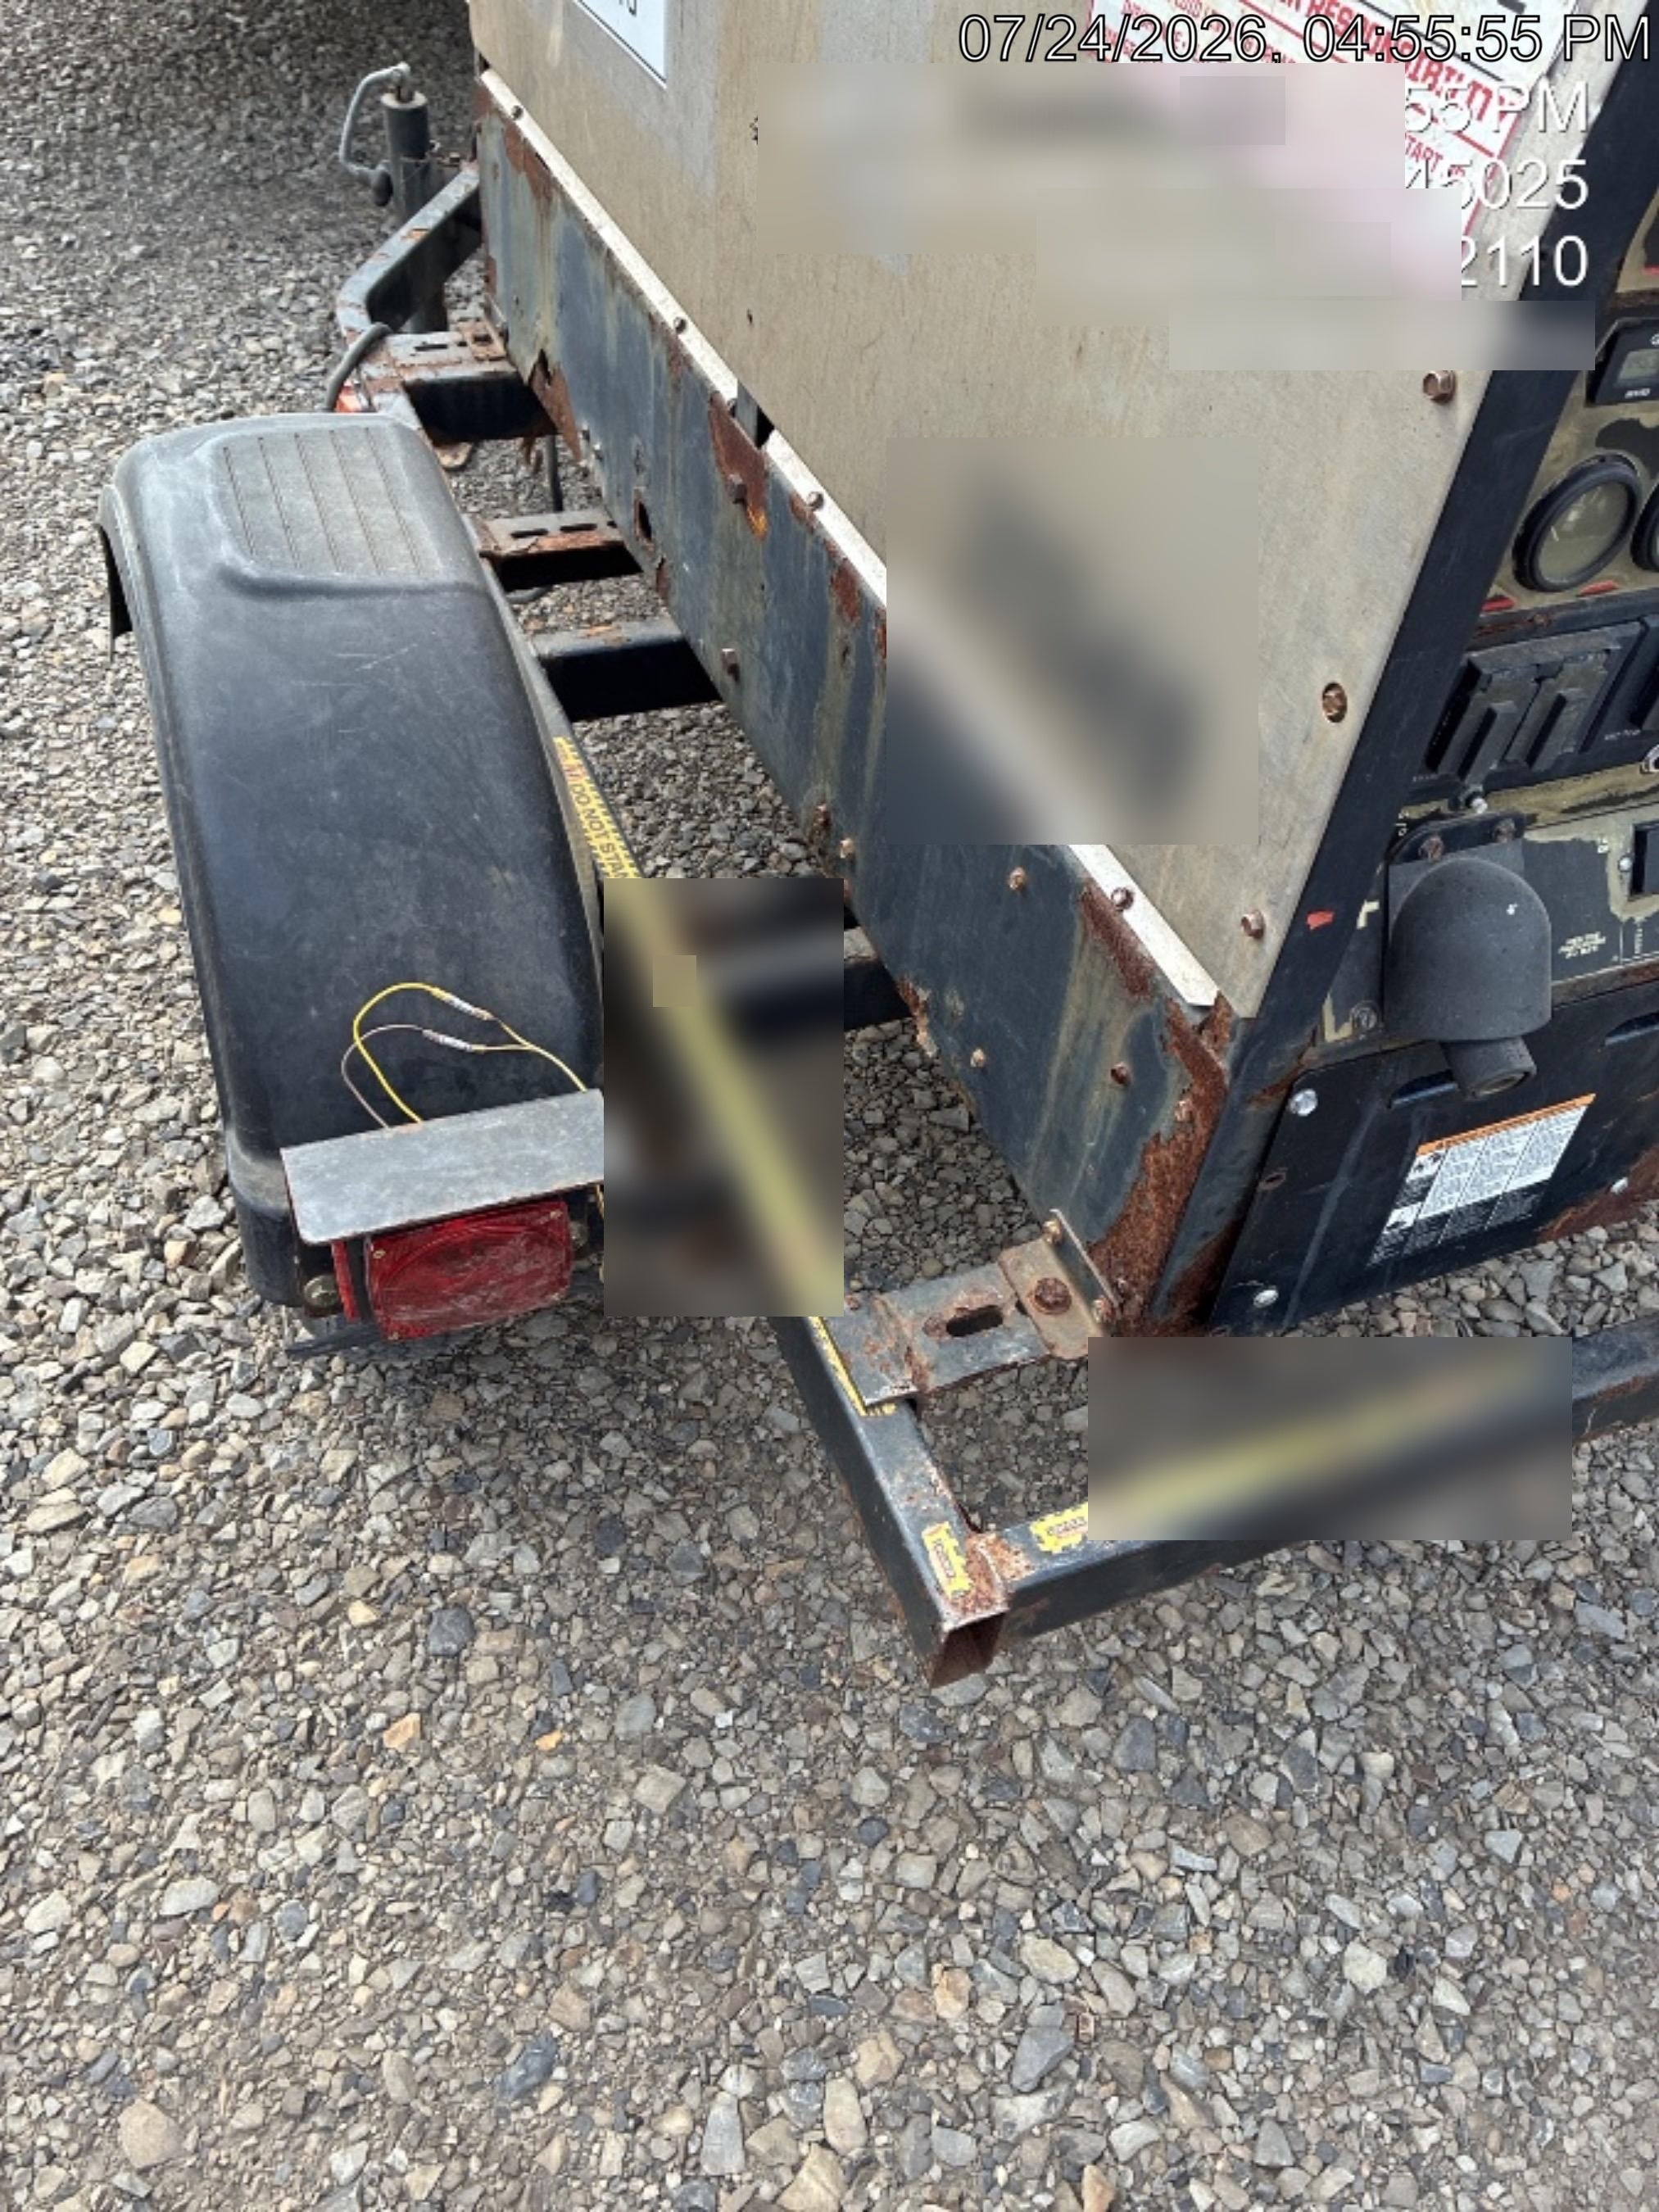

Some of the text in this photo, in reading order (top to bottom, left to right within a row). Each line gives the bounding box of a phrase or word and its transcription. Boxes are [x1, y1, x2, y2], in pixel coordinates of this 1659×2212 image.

[1404, 133, 1444, 173] TART
[569, 782, 592, 805] DO
[582, 807, 610, 840] NOT
